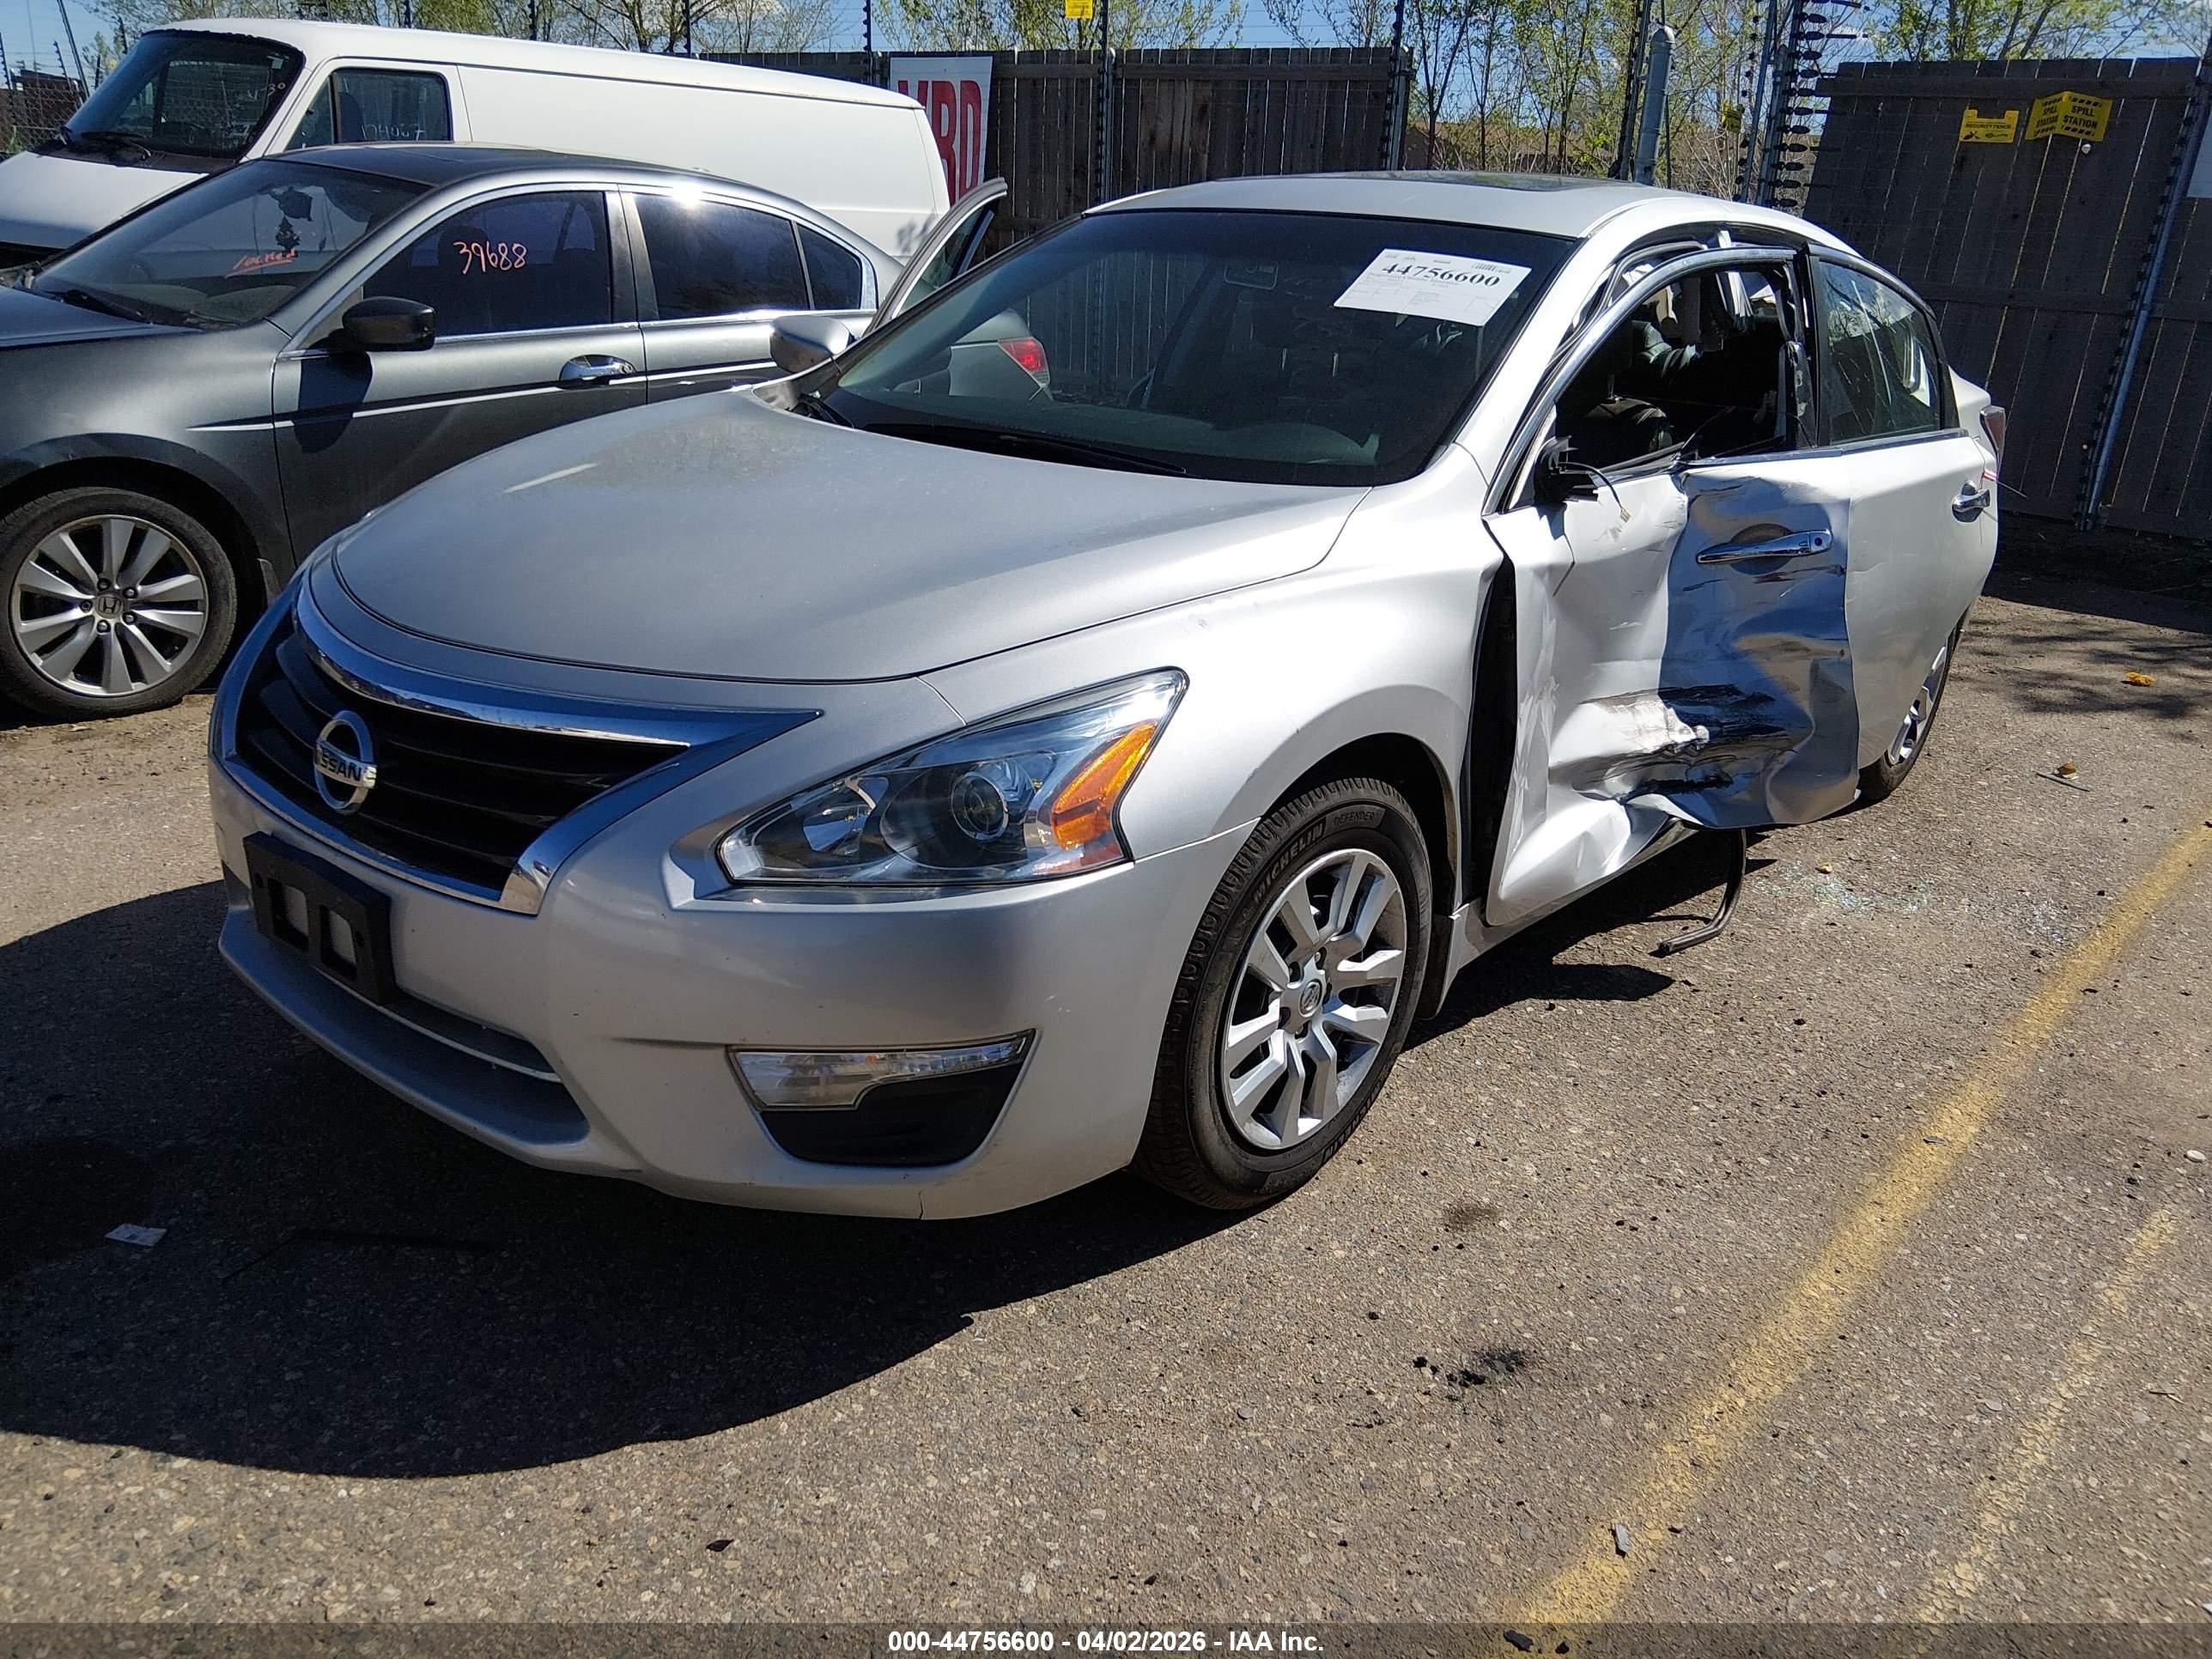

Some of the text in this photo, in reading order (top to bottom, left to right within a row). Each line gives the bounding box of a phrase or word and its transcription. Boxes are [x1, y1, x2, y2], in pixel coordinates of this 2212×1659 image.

[2063, 115, 2098, 129] STATION
[2071, 105, 2095, 117] SPILL
[898, 81, 982, 207] RD
[453, 240, 527, 275] 39688
[1381, 262, 1502, 288] 44756600
[317, 747, 362, 782] SSAN
[1334, 811, 1375, 826] DEFENDER
[1254, 822, 1324, 902] MICHELIN
